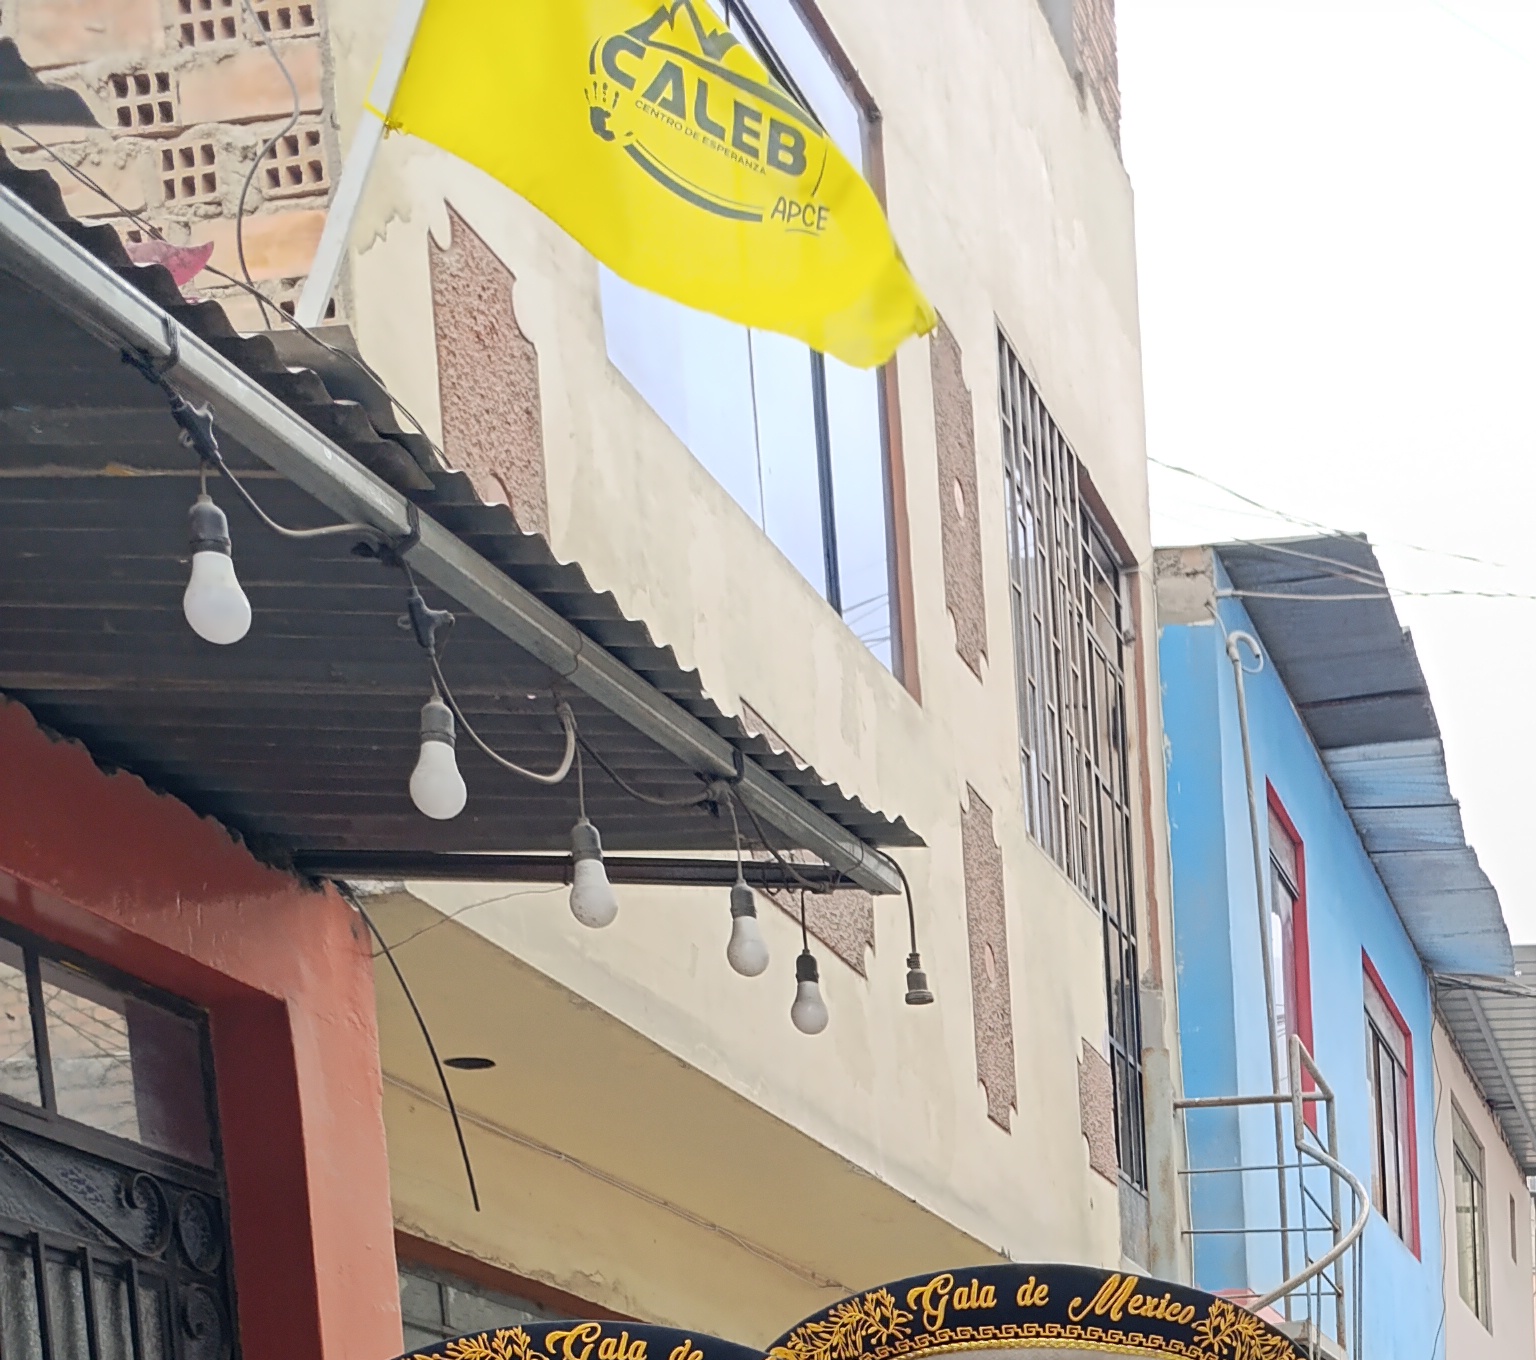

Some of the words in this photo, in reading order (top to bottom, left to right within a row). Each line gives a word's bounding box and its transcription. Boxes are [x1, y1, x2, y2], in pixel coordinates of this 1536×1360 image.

[601, 34, 807, 176] CALEB
[634, 99, 683, 132] CENTRO
[684, 126, 700, 141] DE
[701, 135, 767, 176] ESPERANZA
[770, 196, 830, 231] APCE
[906, 1273, 997, 1332] Gala
[1016, 1275, 1049, 1308] de
[1068, 1272, 1197, 1324] Mexico
